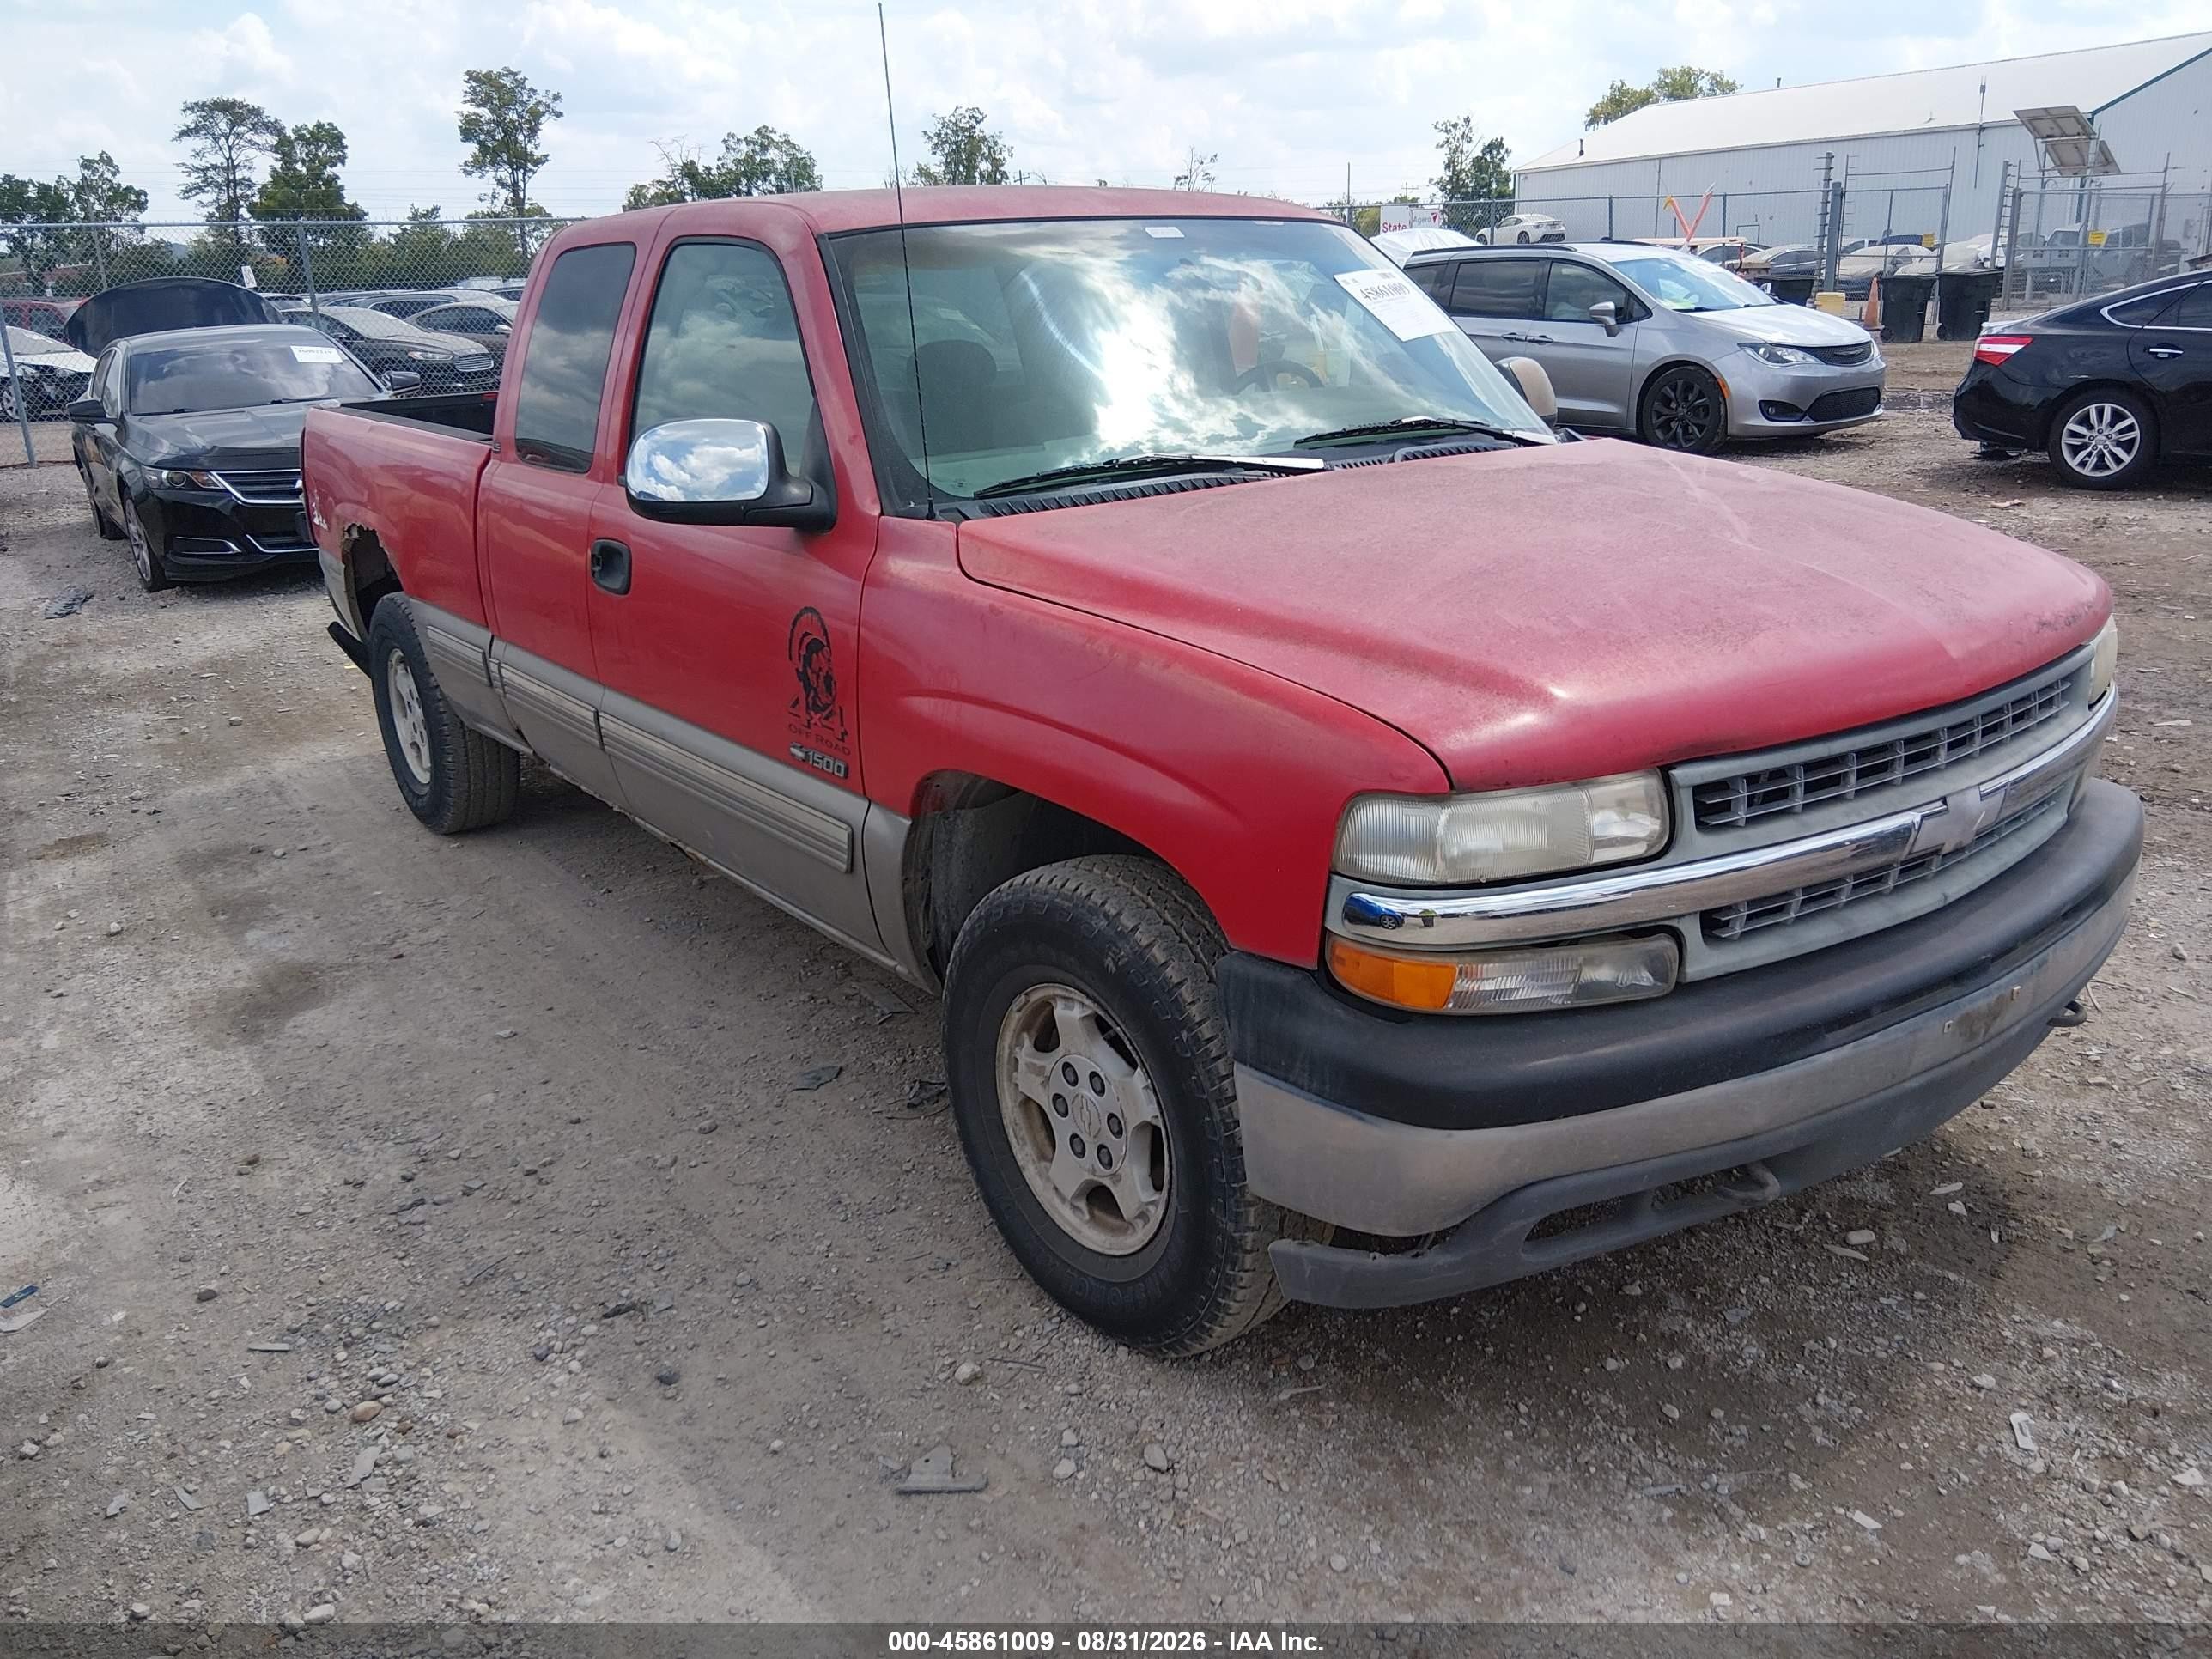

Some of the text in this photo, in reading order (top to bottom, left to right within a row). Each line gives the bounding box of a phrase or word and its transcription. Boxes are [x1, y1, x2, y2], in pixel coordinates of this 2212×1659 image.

[1382, 222, 1407, 234] State
[1359, 282, 1410, 301] 45861009
[816, 734, 851, 756] ROAD
[807, 750, 846, 777] 1500
